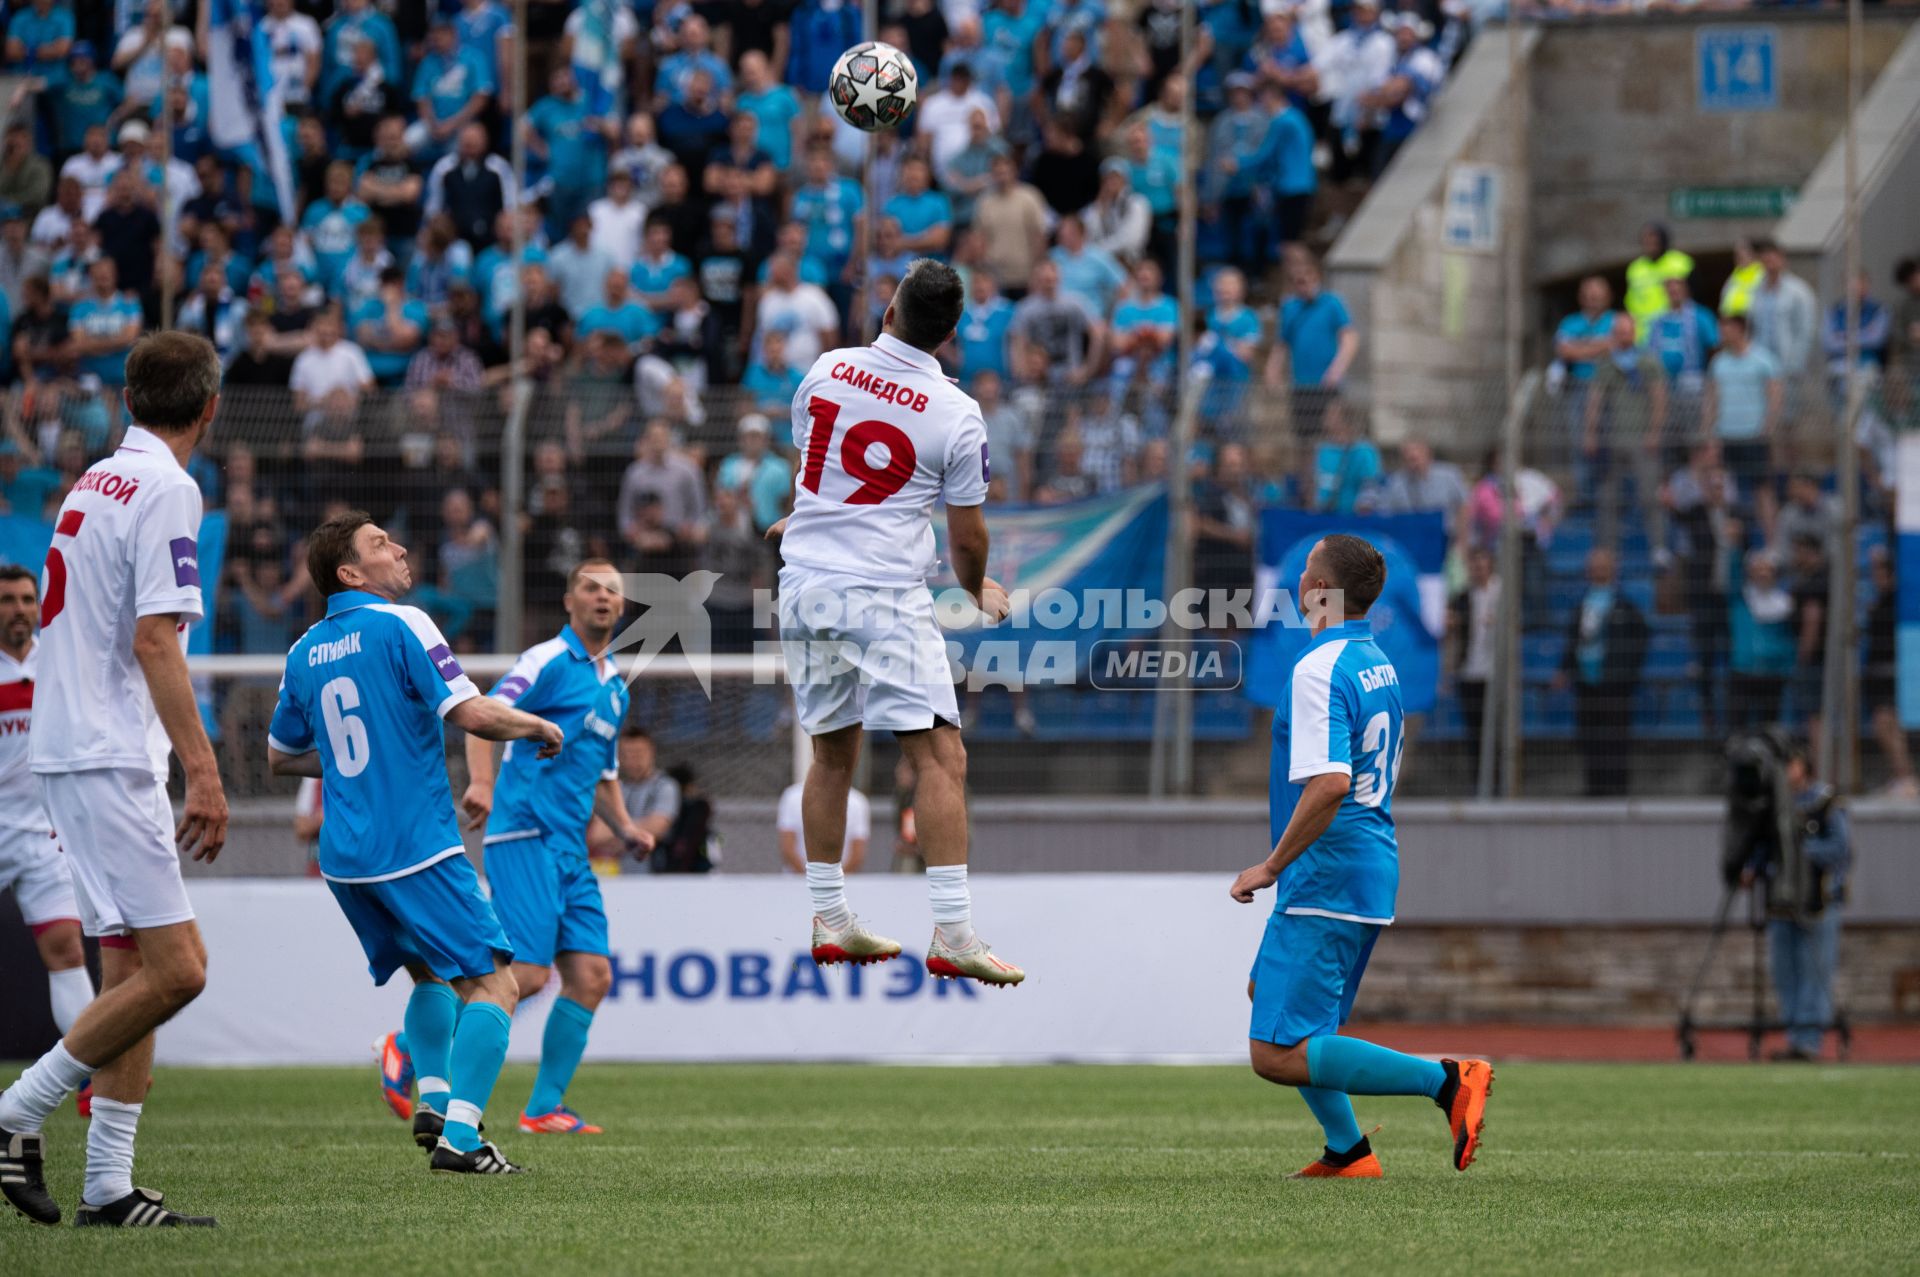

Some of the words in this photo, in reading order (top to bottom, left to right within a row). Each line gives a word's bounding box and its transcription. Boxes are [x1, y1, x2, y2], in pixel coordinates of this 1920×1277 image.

[1713, 46, 1763, 87] 14
[831, 362, 929, 413] САМЕДОВ
[801, 395, 917, 505] 19
[308, 631, 362, 667] СПИВАК
[320, 676, 370, 778] 6
